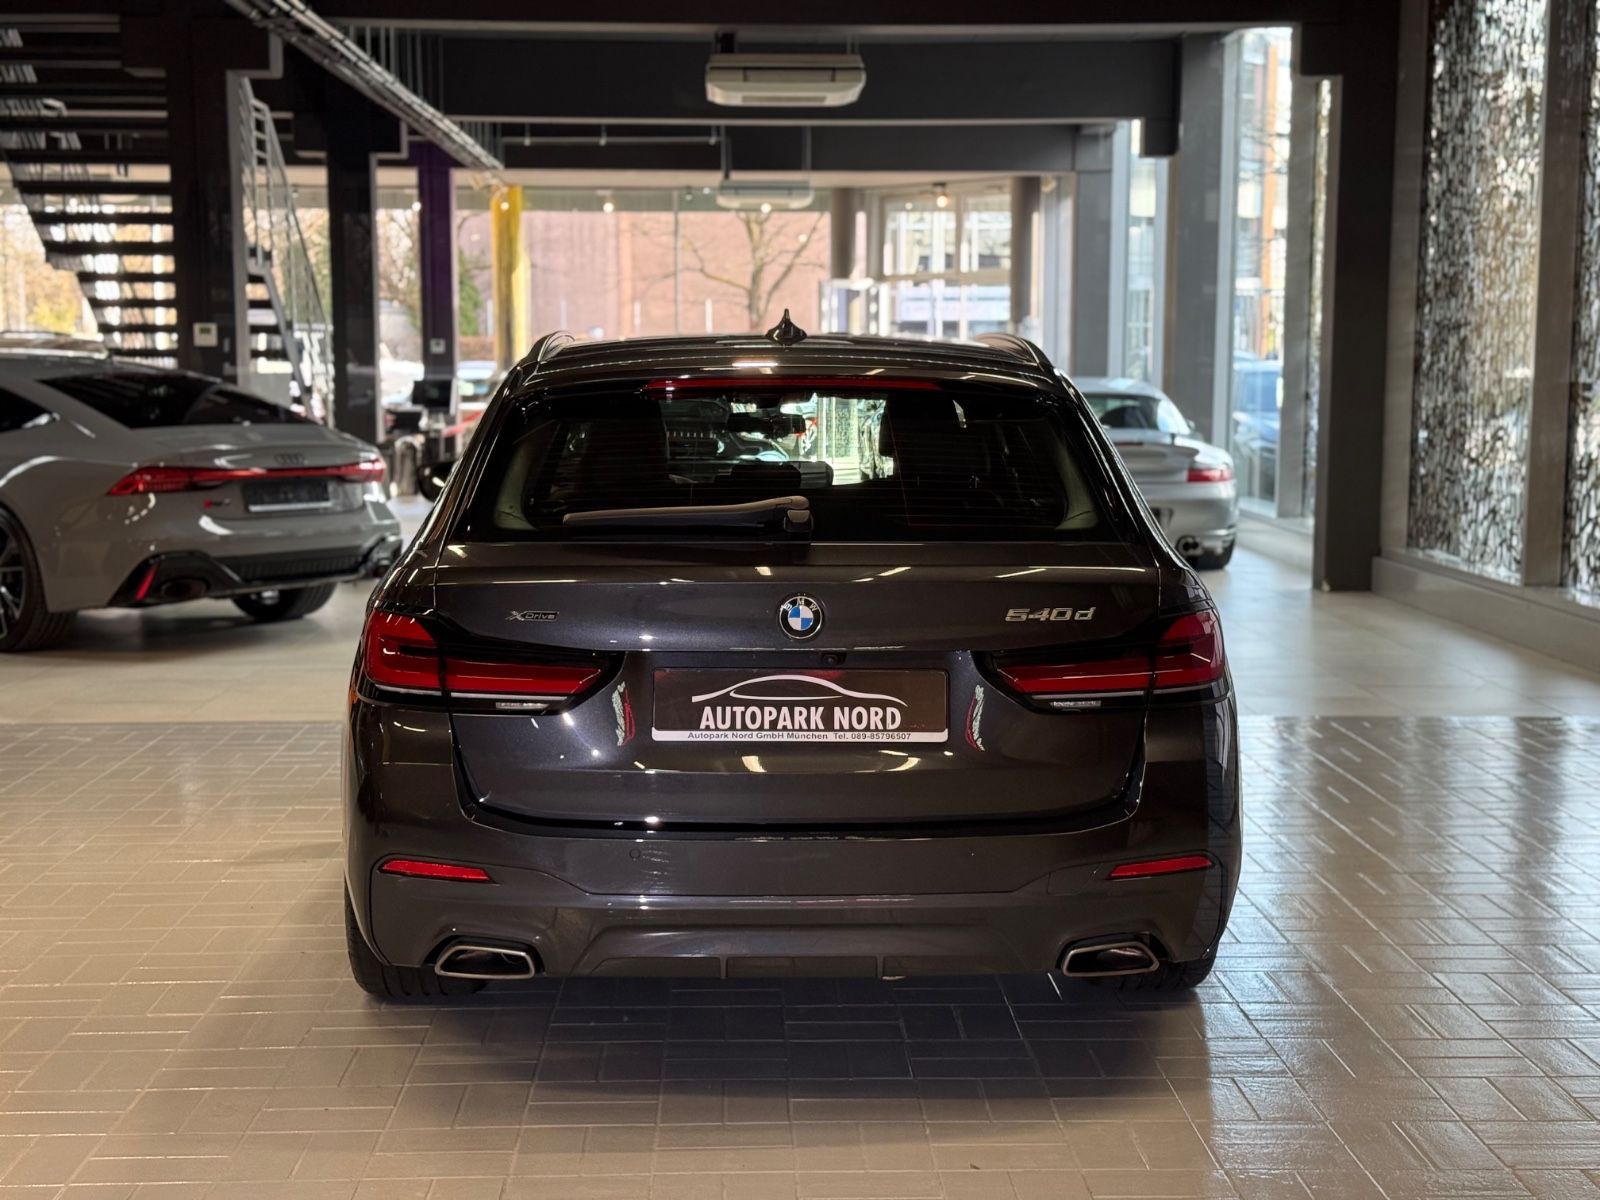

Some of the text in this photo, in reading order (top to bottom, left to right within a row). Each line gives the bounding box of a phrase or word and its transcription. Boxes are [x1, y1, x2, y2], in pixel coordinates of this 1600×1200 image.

[1005, 606, 1097, 621] 540d
[700, 706, 902, 730] AUTOPARK NORD
[688, 732, 729, 740] Autopark
[732, 732, 754, 740] Nord
[756, 732, 785, 740] GmbH
[787, 732, 828, 740] München
